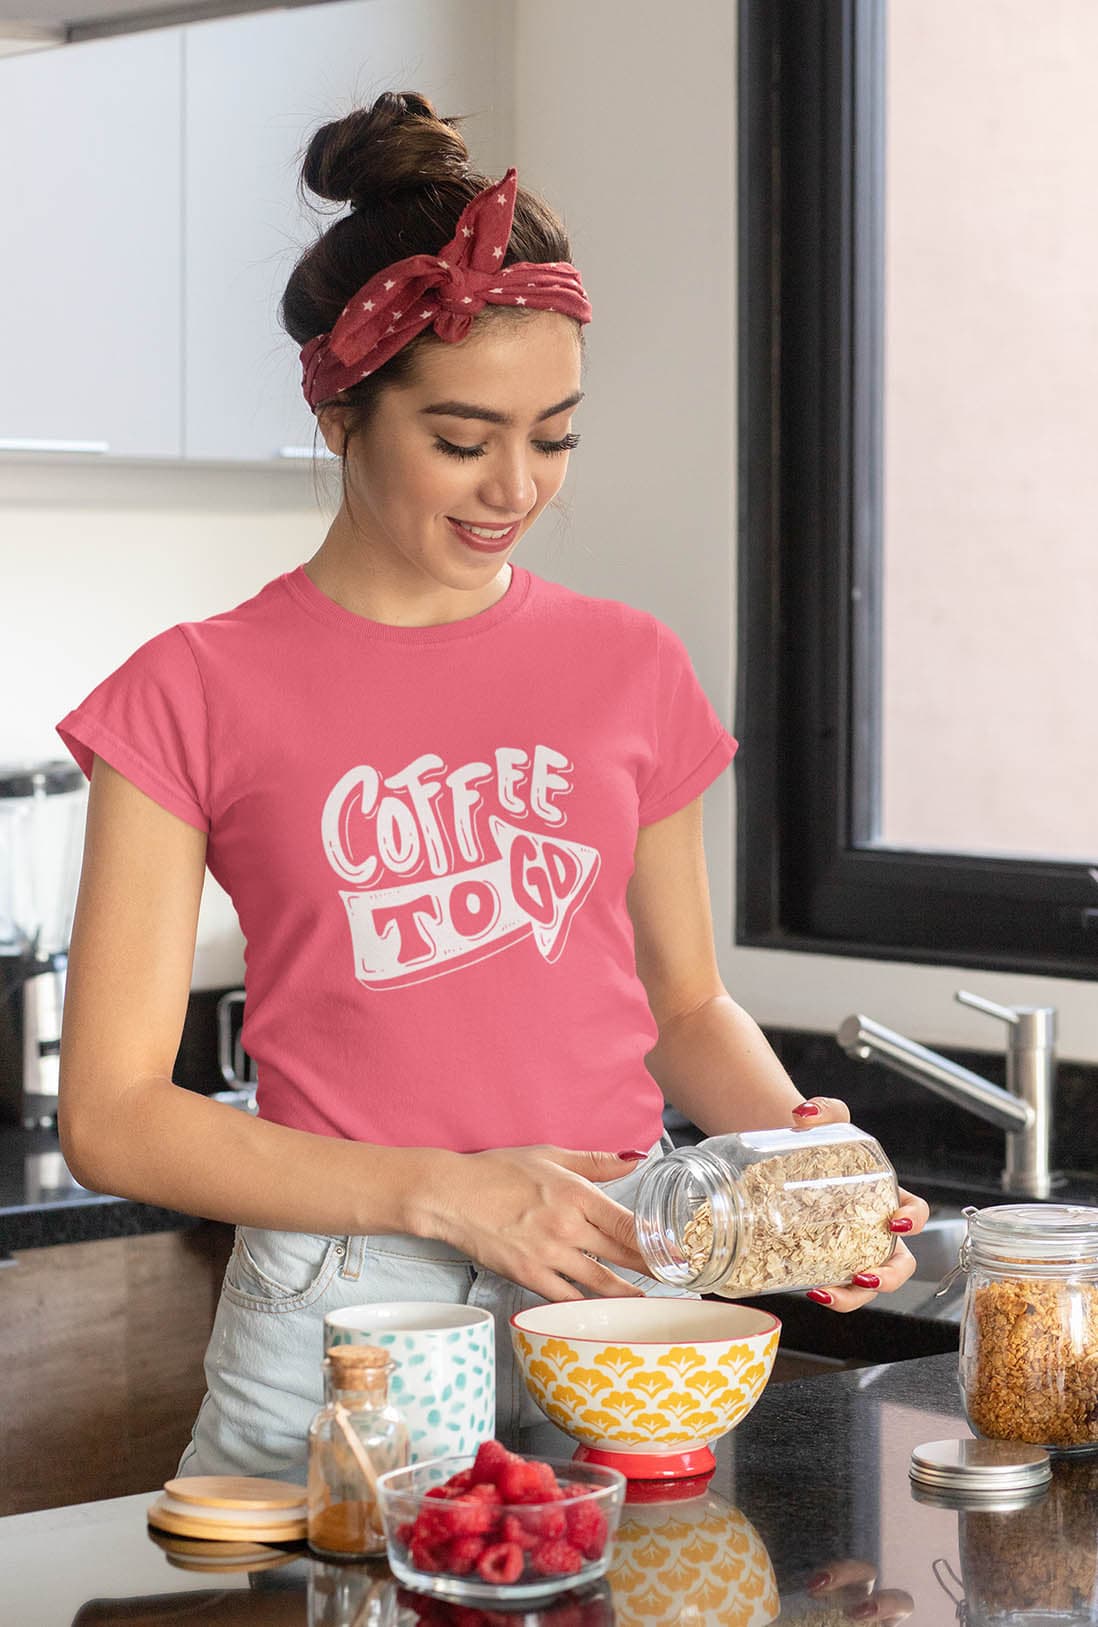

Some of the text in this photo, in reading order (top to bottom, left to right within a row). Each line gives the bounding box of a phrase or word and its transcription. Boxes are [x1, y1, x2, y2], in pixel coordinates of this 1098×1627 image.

[321, 745, 572, 885] COFFEE
[371, 834, 581, 965] TO GO
